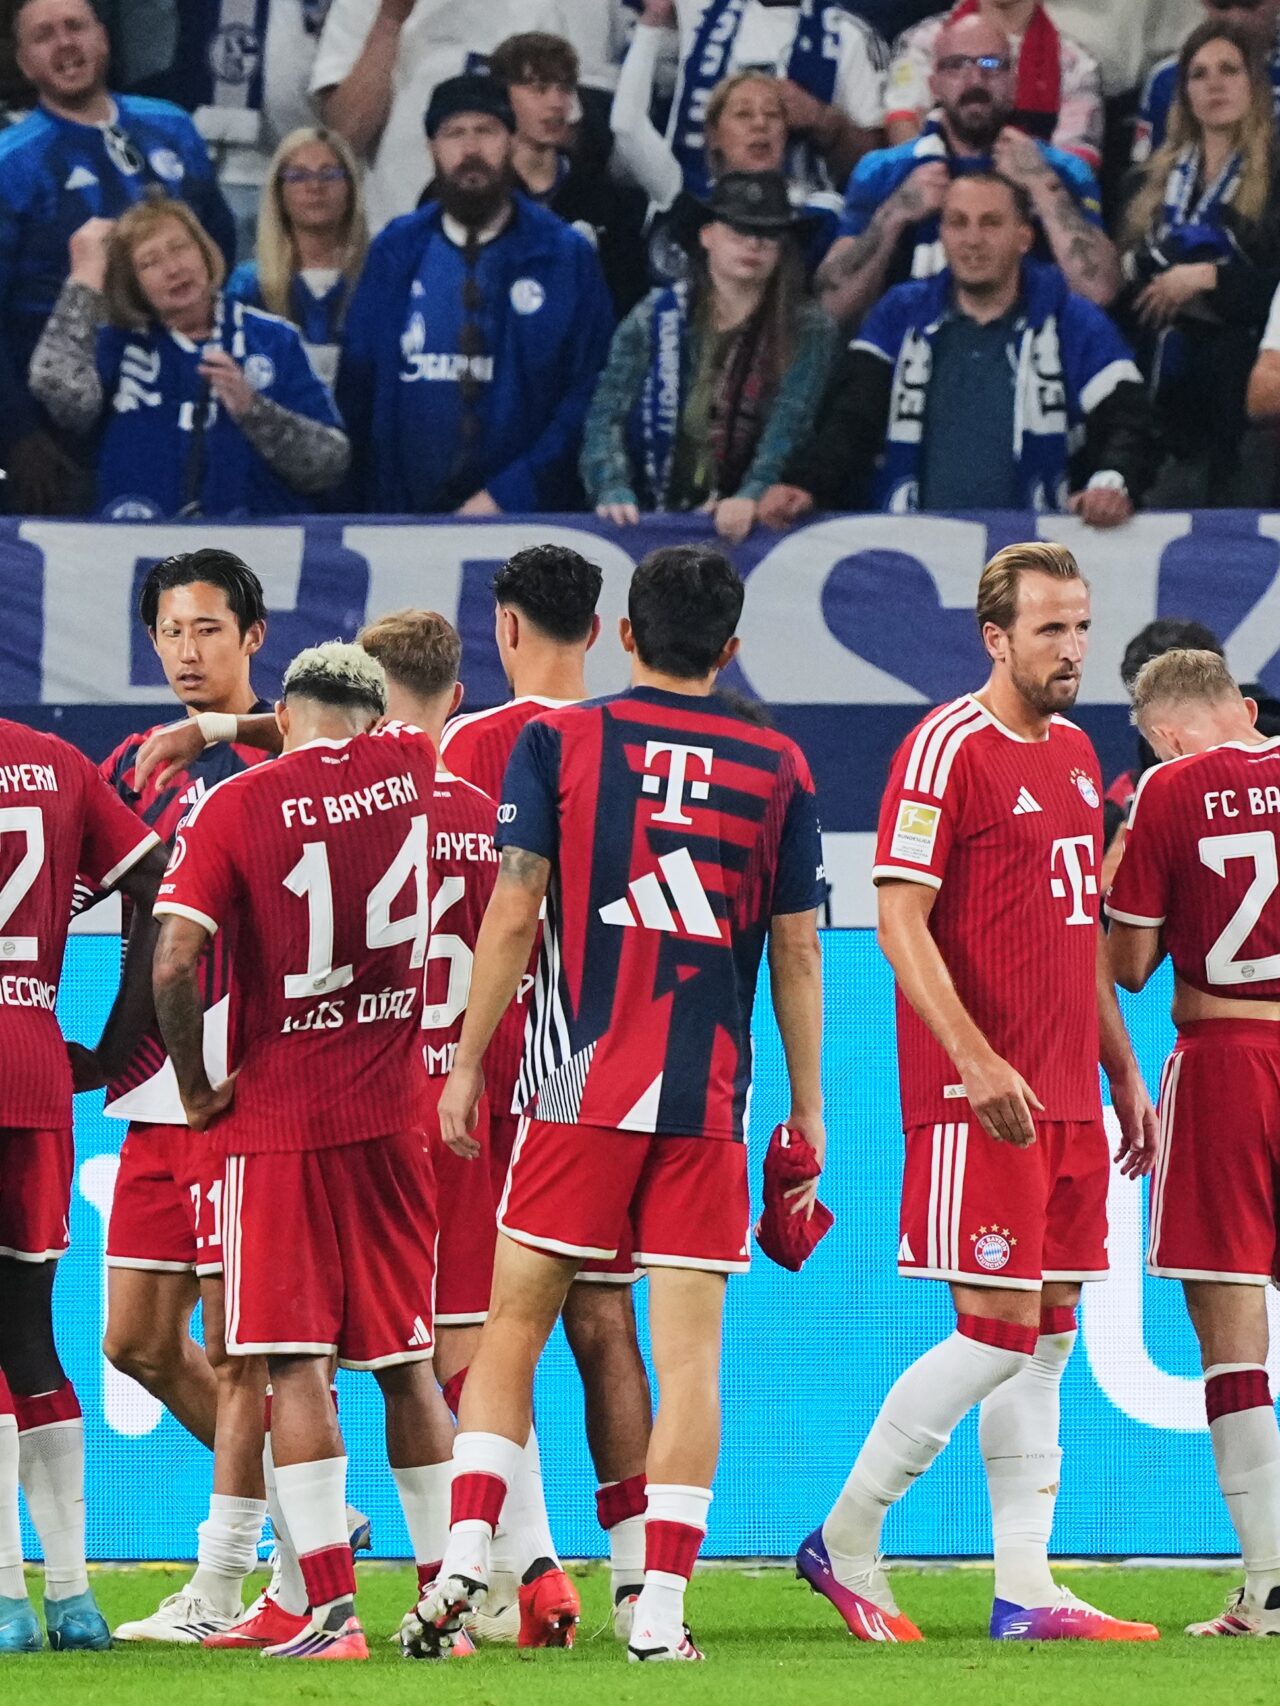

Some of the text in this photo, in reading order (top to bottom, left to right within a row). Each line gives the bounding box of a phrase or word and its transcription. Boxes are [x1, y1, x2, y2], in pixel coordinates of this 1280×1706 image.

[281, 771, 419, 828] FC BAYERN
[1204, 789, 1240, 820] FC
[282, 813, 430, 999] 14
[421, 876, 474, 1029] 6
[357, 986, 417, 1024] DÍAZ
